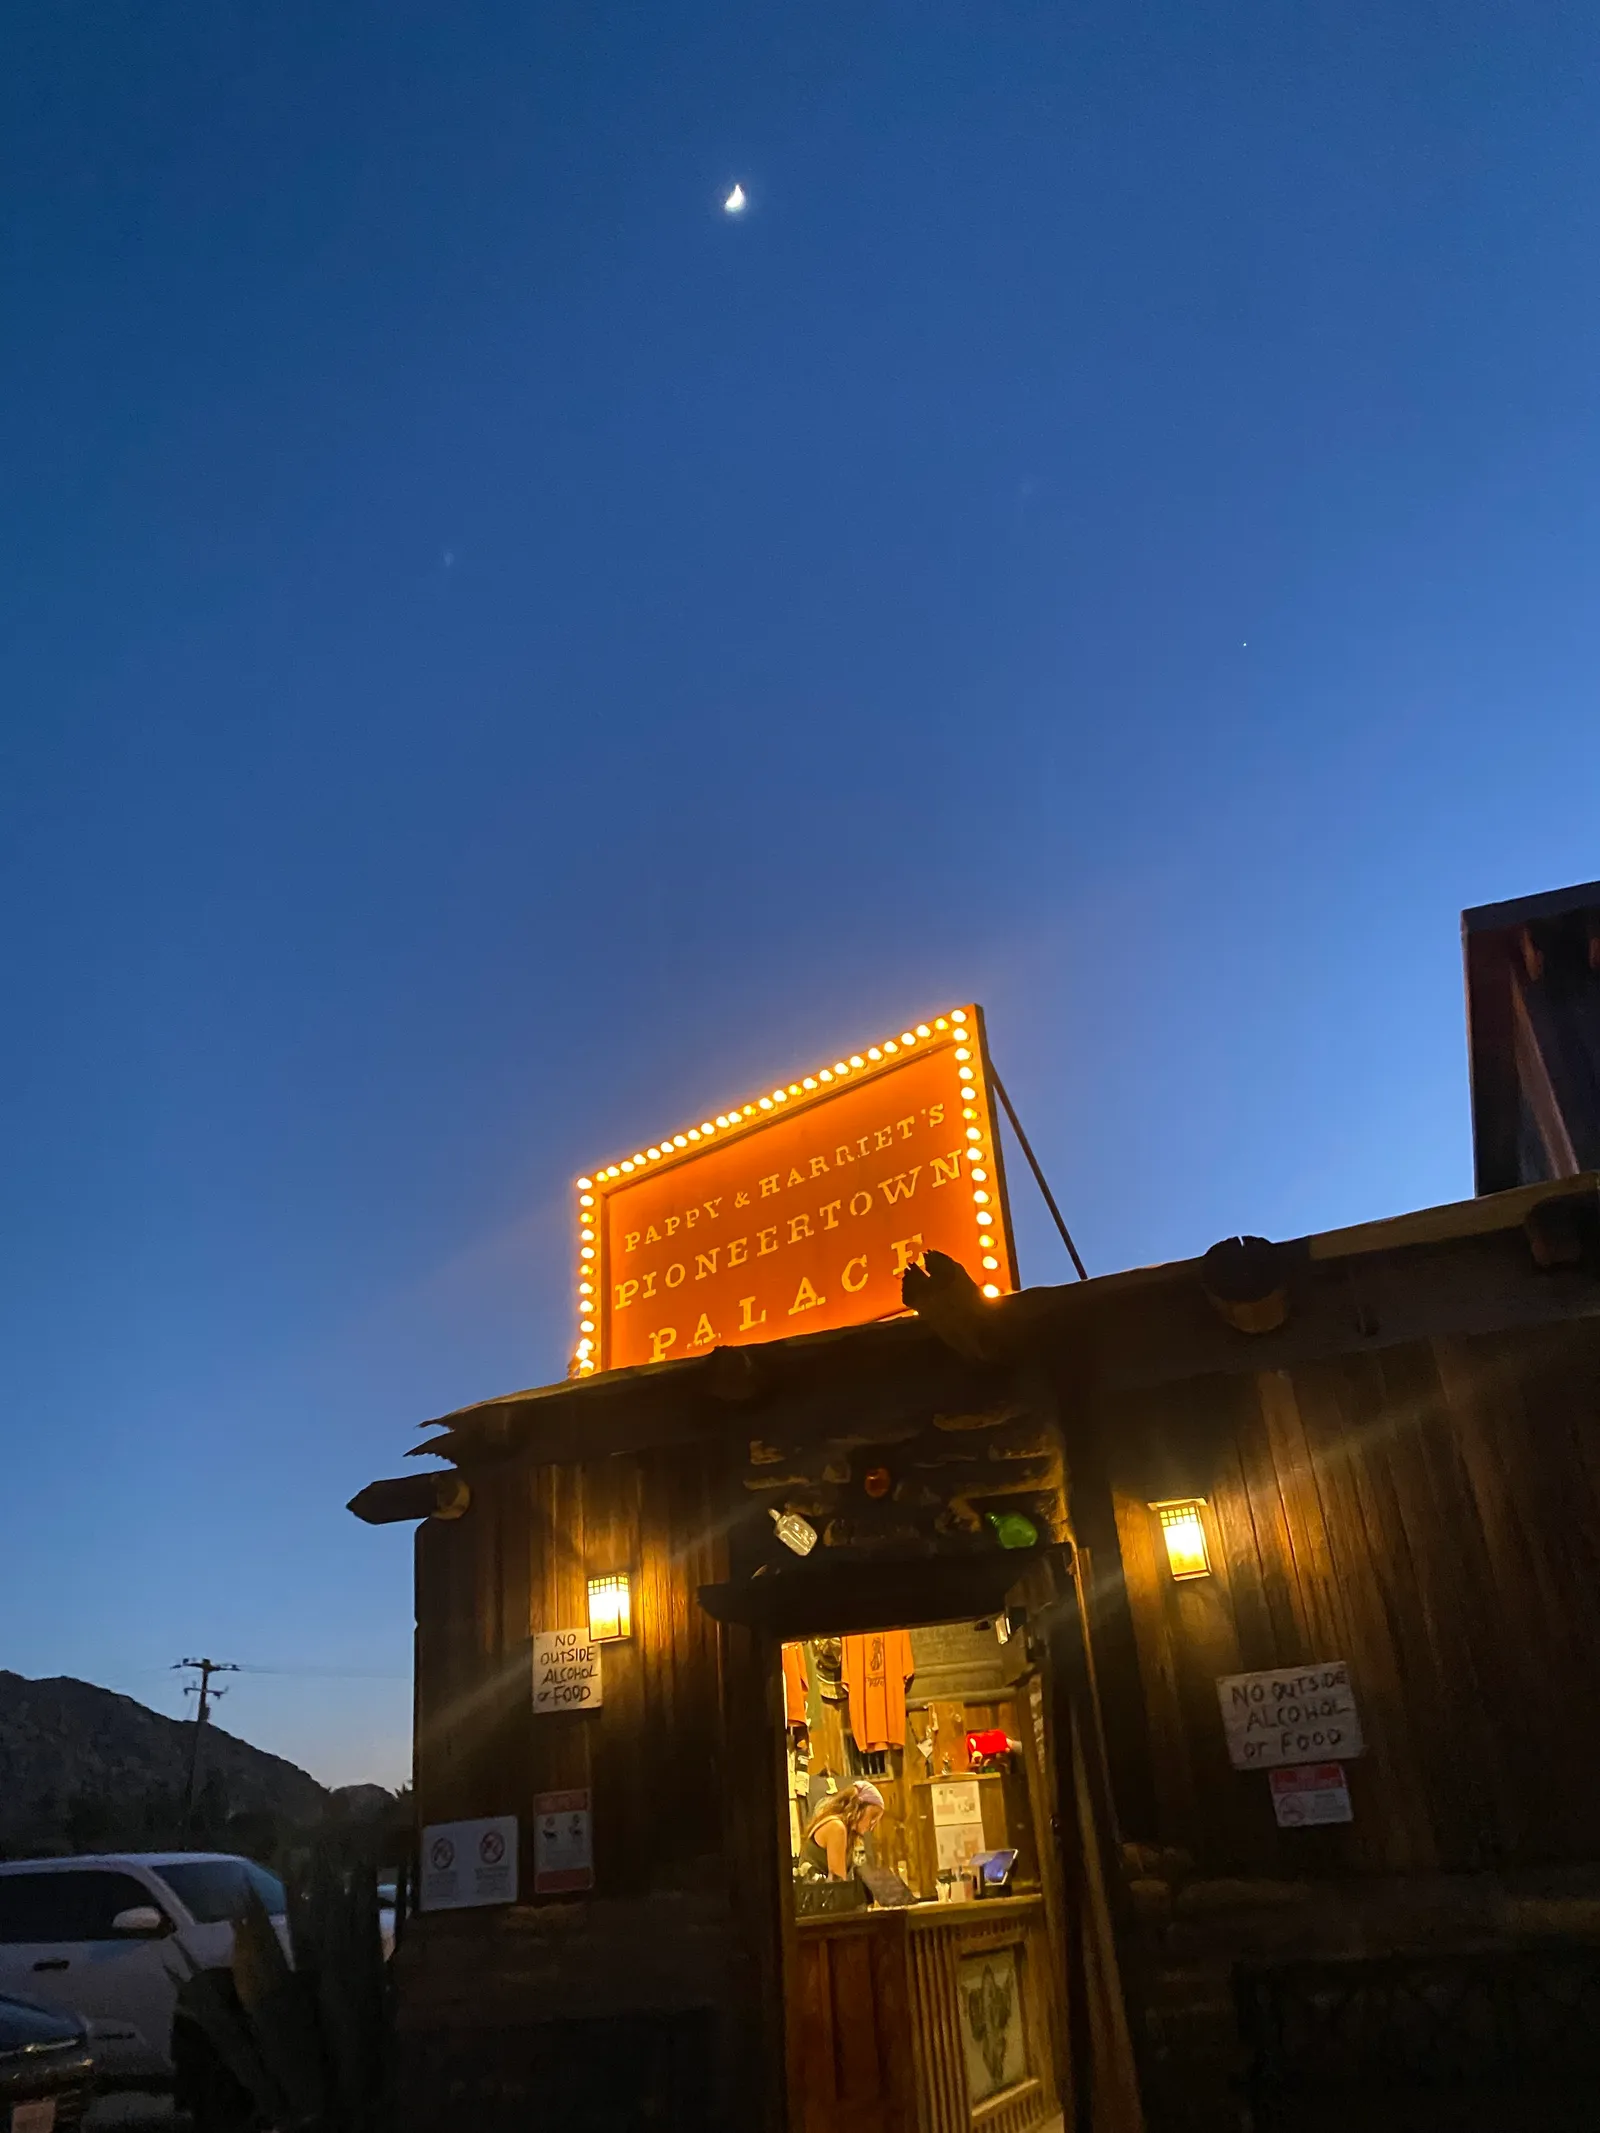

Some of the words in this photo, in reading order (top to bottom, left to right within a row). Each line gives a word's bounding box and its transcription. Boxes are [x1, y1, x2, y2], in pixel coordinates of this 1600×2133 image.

[624, 1196, 723, 1252] PAPPY
[733, 1190, 750, 1208] &
[759, 1103, 945, 1198] HARRIET'S
[613, 1149, 963, 1310] PIONEERTOWN
[649, 1233, 927, 1363] PALACE
[555, 1633, 577, 1647] NO
[540, 1645, 595, 1666] OUTSIDE
[541, 1665, 599, 1685] ALCOHOL
[551, 1685, 591, 1705] FOOD
[1232, 1684, 1264, 1707] NO
[1246, 1699, 1351, 1732] ALCOHOL
[1281, 1728, 1341, 1756] FOOD
